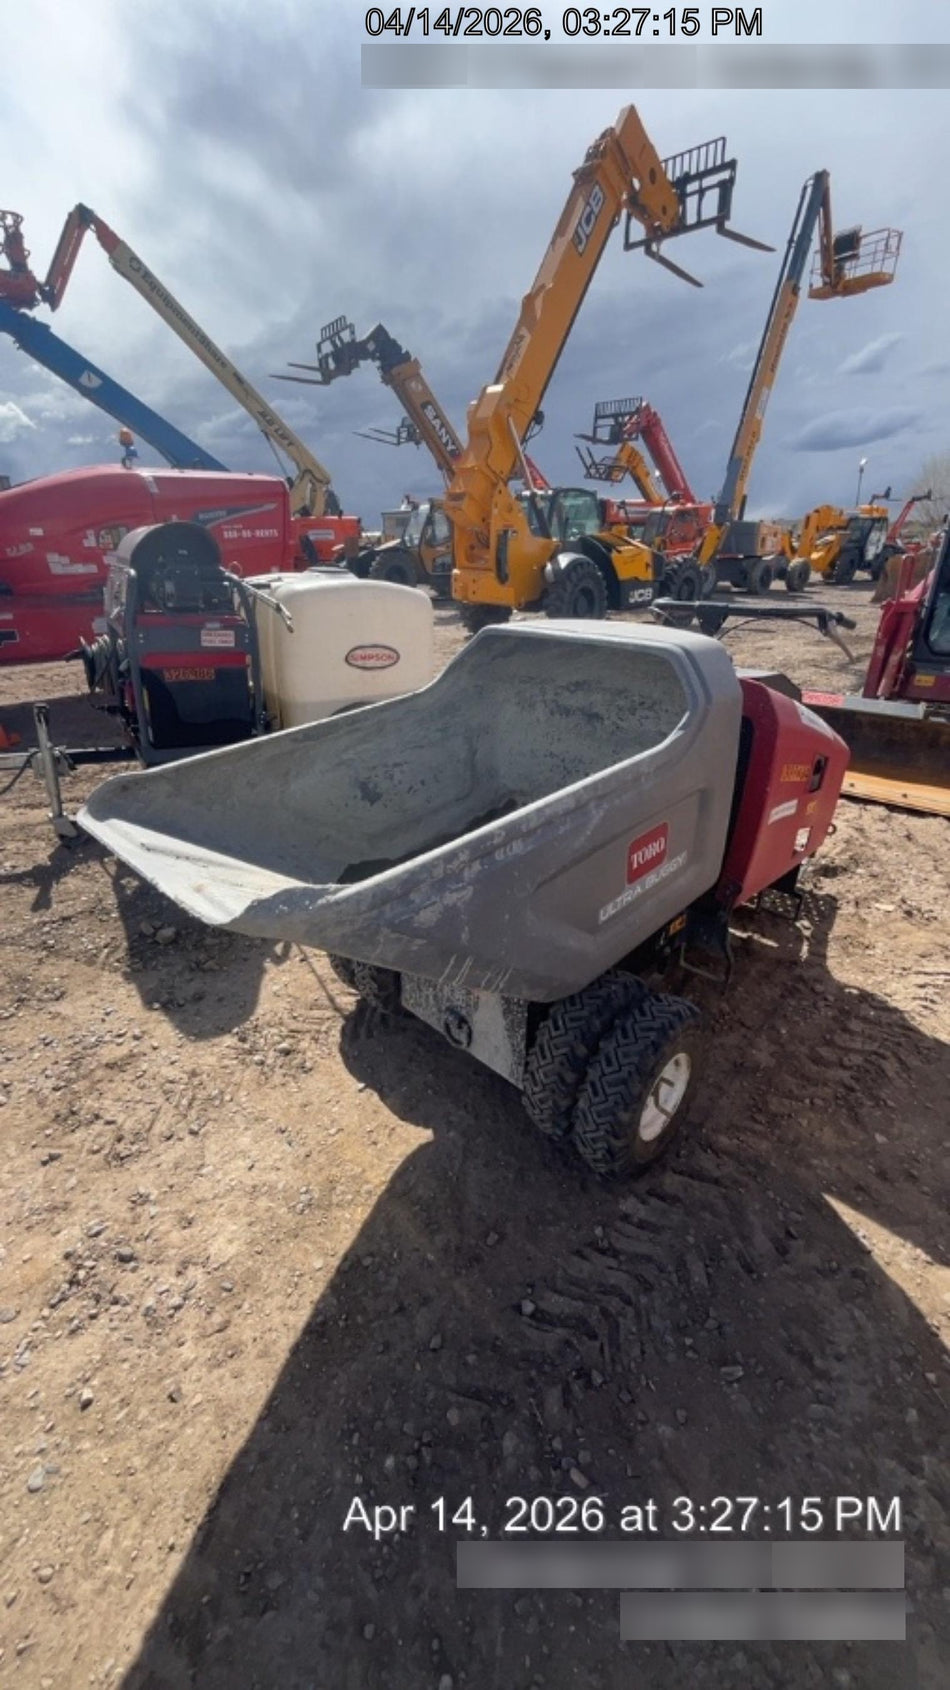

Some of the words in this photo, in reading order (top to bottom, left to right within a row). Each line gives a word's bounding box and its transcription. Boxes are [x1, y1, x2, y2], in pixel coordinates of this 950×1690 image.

[574, 188, 605, 253] JCB
[423, 404, 457, 456] SANY
[629, 588, 653, 604] JCB
[350, 652, 395, 663] SIMPSON
[630, 837, 666, 871] TORO
[598, 885, 642, 924] ULTRA
[645, 852, 685, 889] BUGGY
